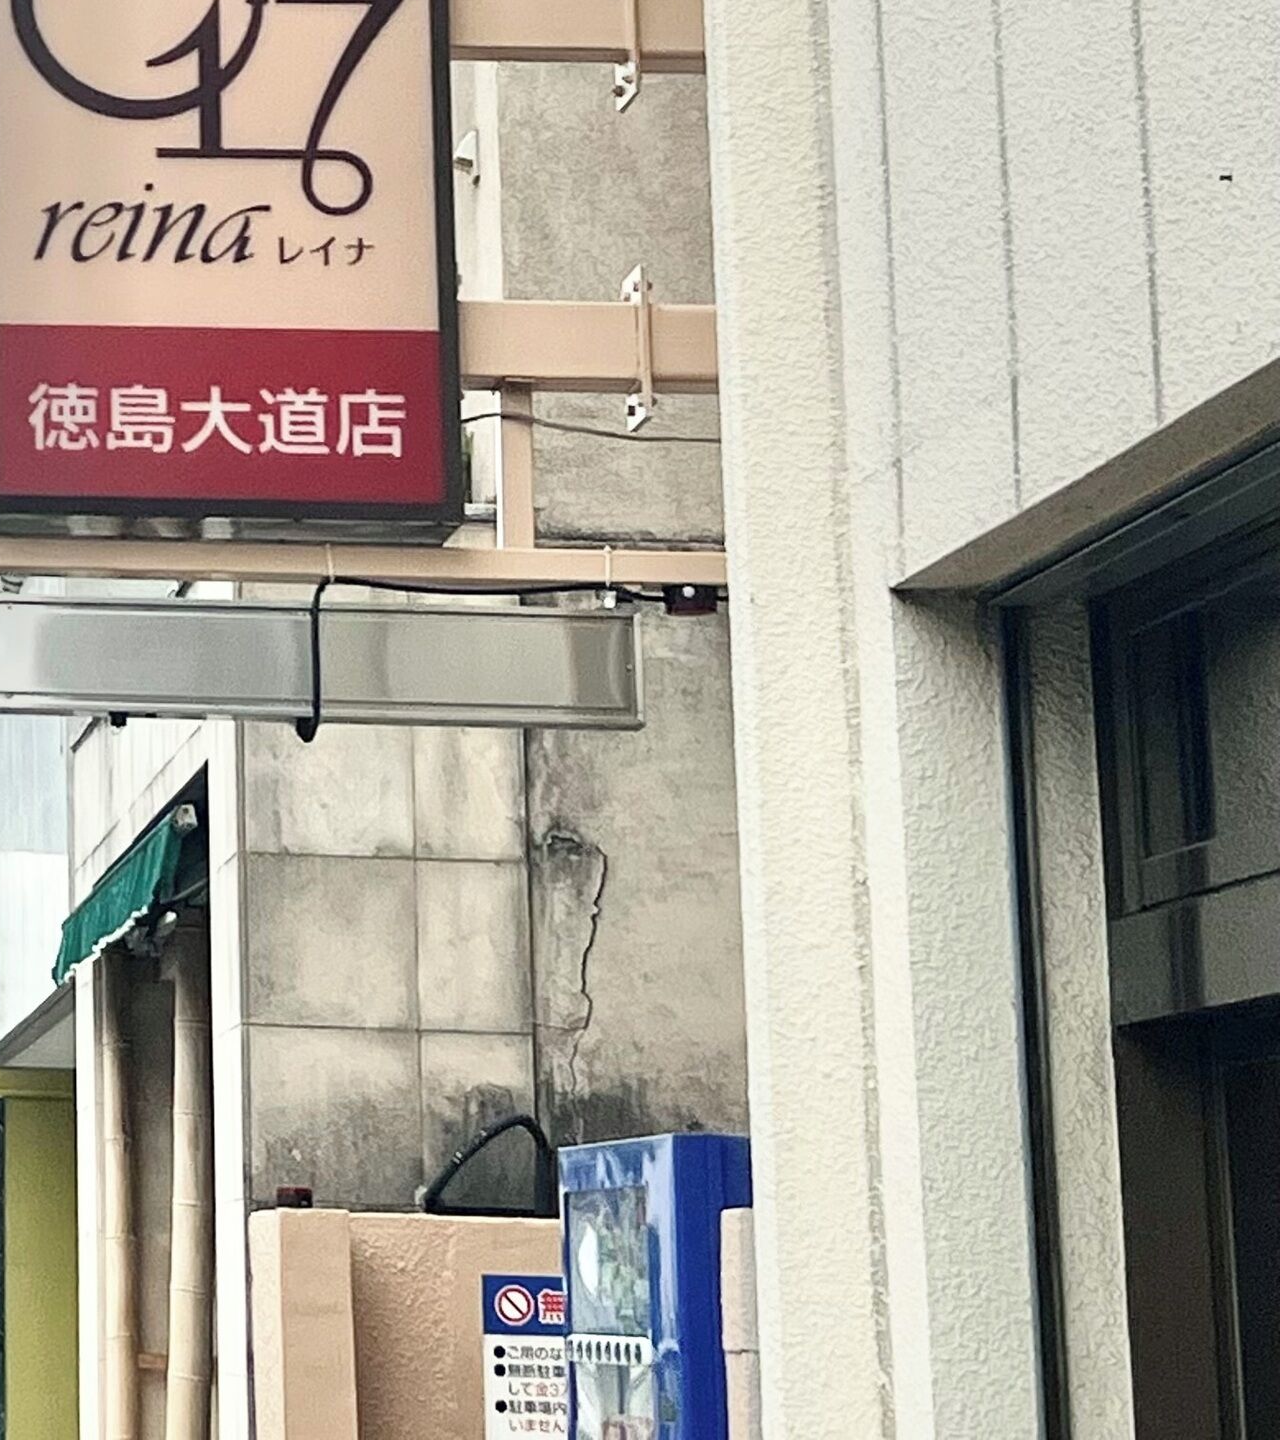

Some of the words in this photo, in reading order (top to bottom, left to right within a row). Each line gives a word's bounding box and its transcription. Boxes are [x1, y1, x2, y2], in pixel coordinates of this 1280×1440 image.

[33, 183, 272, 265] reina
[277, 236, 376, 267] レイナ
[27, 382, 408, 459] 徳島大道店
[508, 1417, 565, 1434] いません
